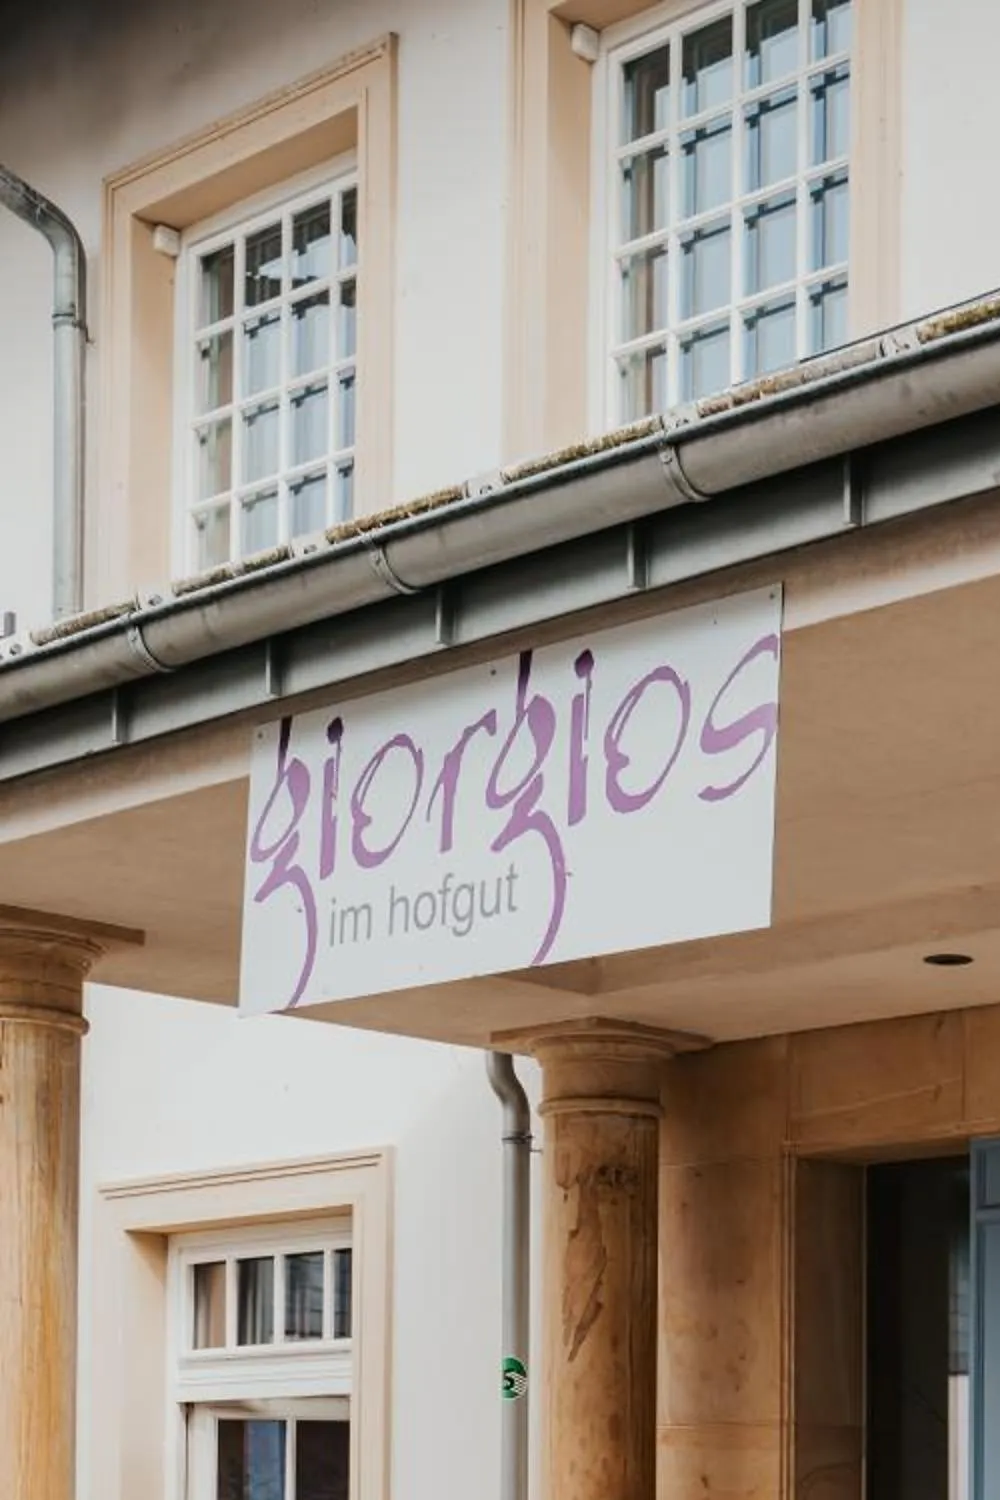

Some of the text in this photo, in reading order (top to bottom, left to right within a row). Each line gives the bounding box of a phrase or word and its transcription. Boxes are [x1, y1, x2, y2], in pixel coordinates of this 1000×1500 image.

[249, 633, 779, 1009] giorgios
[328, 861, 519, 948] im hofgut
